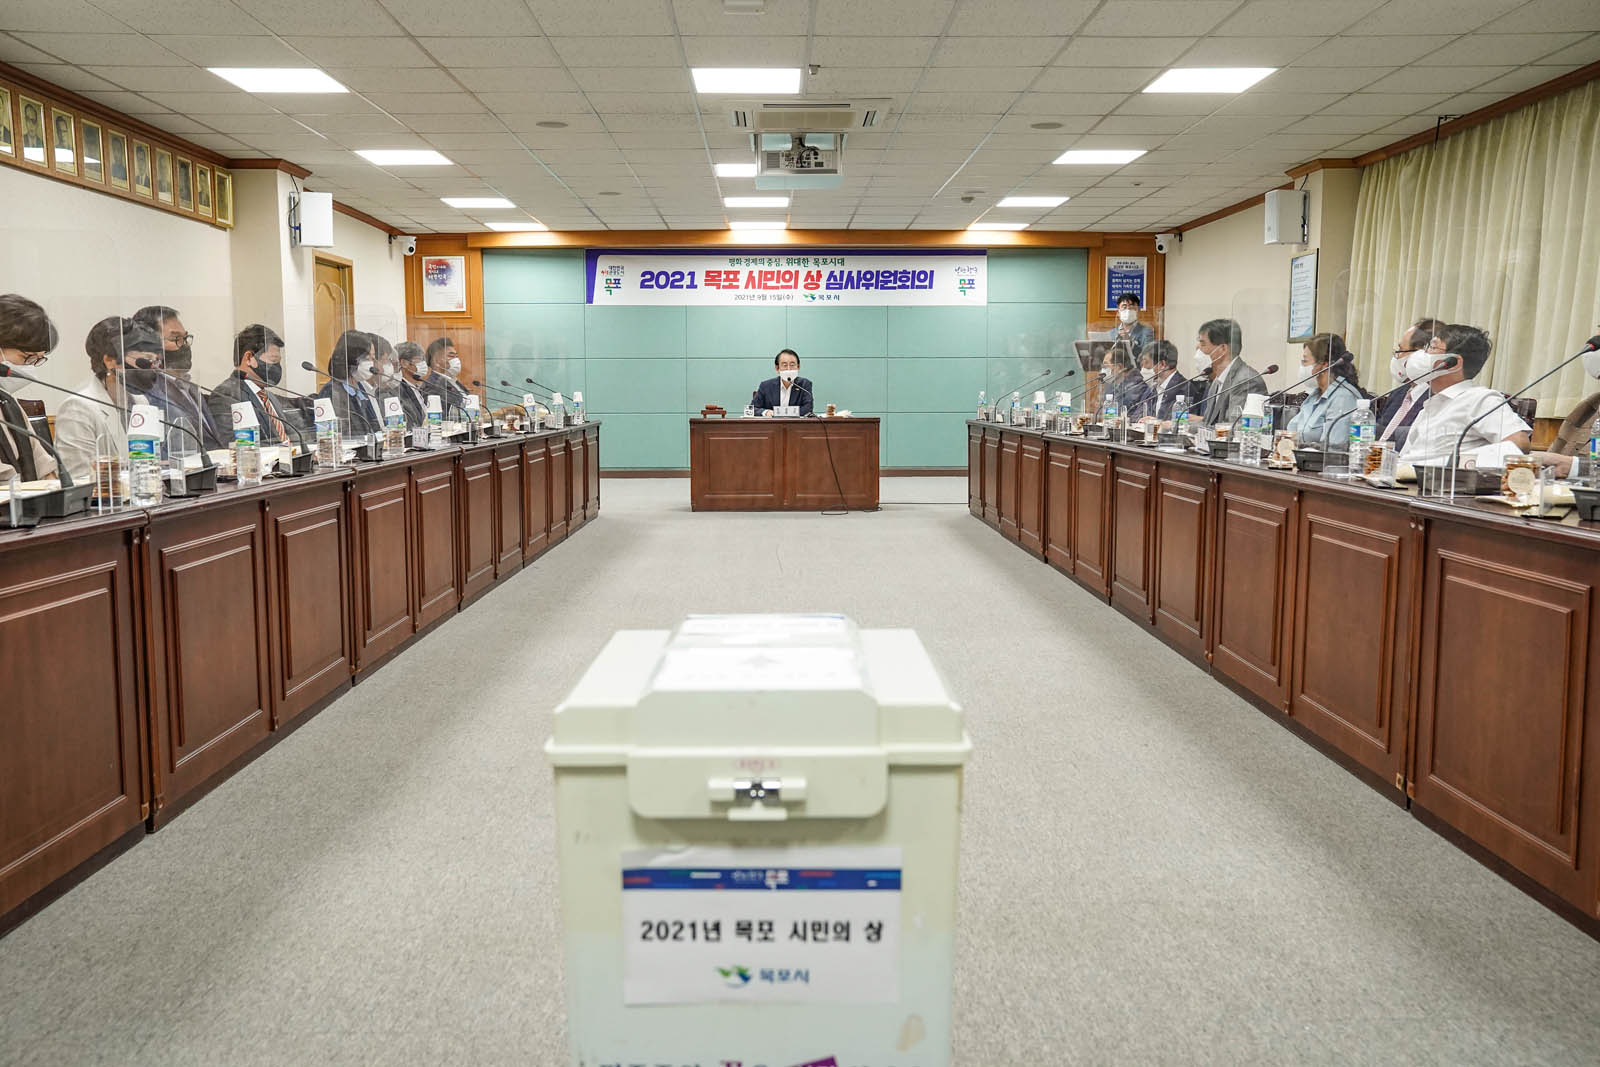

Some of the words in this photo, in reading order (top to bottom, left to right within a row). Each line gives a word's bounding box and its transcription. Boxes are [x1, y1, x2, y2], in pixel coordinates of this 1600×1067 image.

[728, 257, 742, 267] 평화
[744, 257, 765, 267] 경제의
[786, 257, 809, 267] 위대한
[812, 257, 845, 267] 목포시대
[604, 278, 621, 296] 목포
[640, 270, 698, 290] 2021
[704, 269, 741, 290] 목포
[744, 269, 800, 290] 시민의
[803, 269, 823, 290] 상
[825, 269, 935, 291] 심사위원회의
[958, 278, 976, 296] 목포
[769, 294, 794, 302] 15일(수)
[640, 920, 722, 943] 2021년
[734, 920, 776, 943] 목포
[788, 920, 852, 943] 시민의
[864, 920, 885, 943] 상
[759, 968, 810, 984] 목포시
